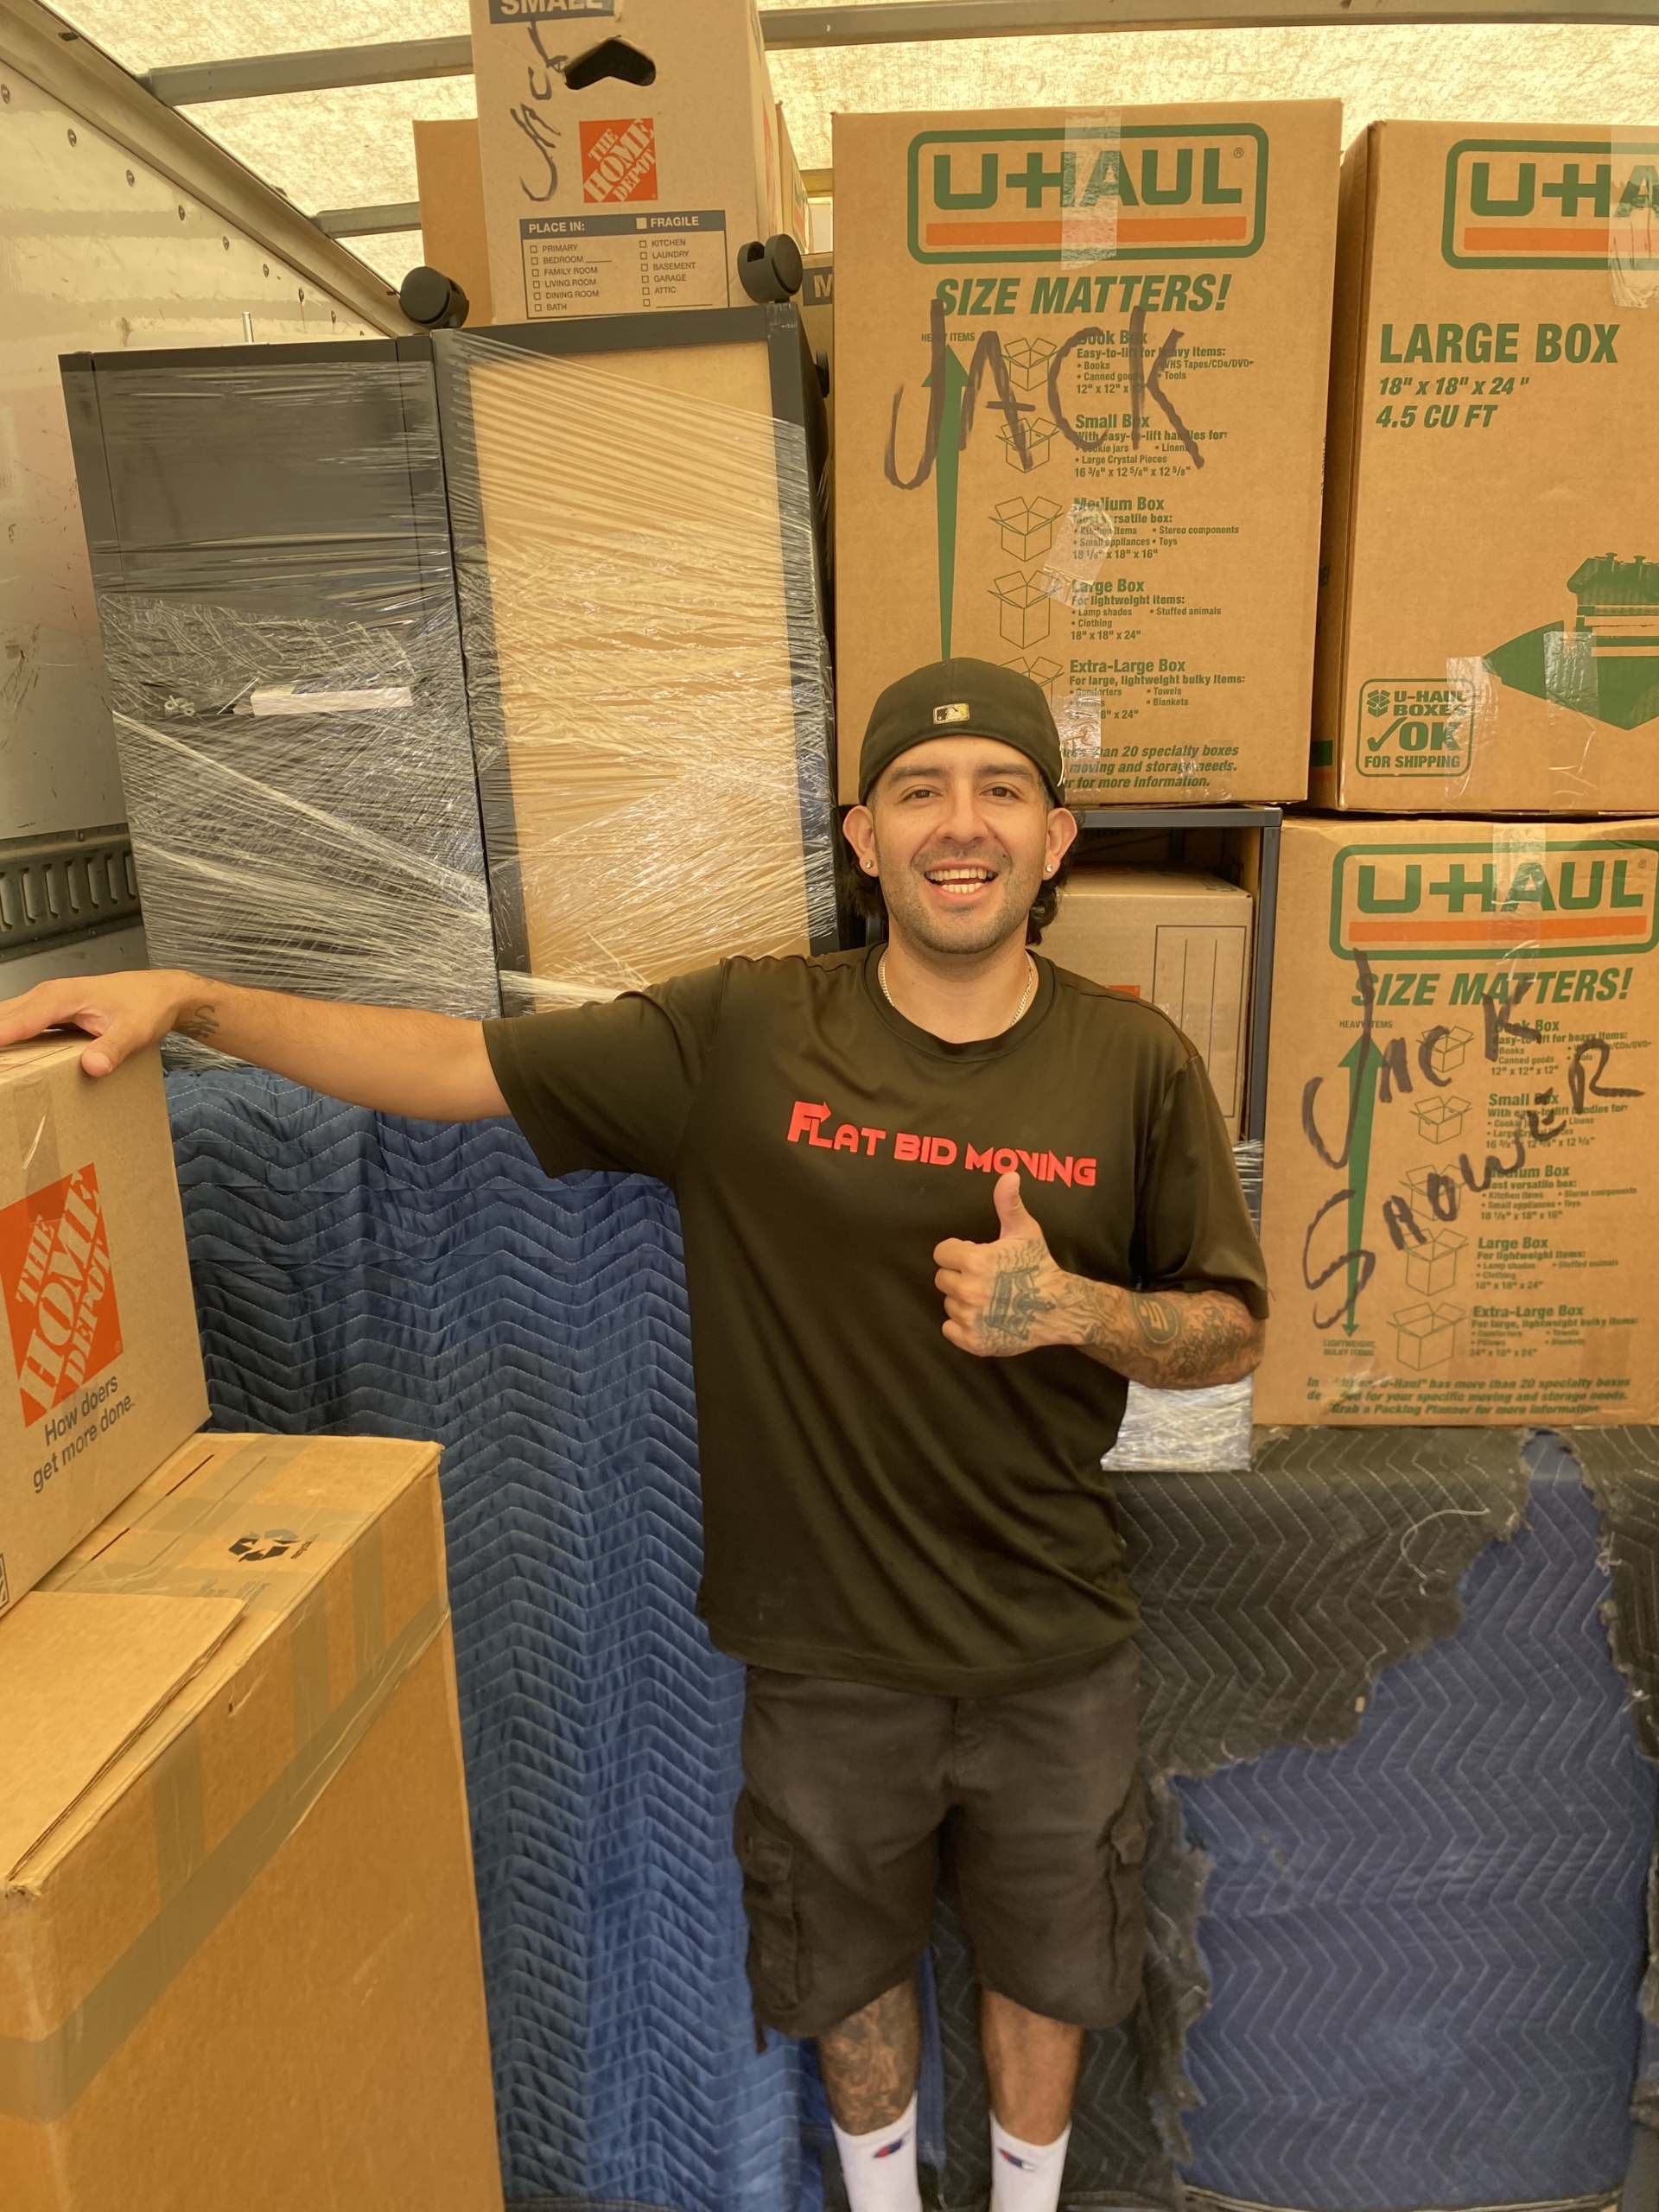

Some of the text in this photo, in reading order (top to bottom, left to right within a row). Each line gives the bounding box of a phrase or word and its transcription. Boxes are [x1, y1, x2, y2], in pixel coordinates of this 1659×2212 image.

[588, 129, 618, 162] THE
[583, 118, 654, 203] HOME
[613, 149, 656, 202] DEPOT
[933, 148, 1242, 210] U-HAUL
[529, 222, 585, 233] PLACE IN:
[651, 217, 699, 227] FRAGILE
[936, 274, 1232, 316] SIZE MATTERS!
[950, 333, 975, 341] ITEMS
[1380, 323, 1620, 364] LARGE BOX
[1077, 384, 1092, 393] 12"
[1105, 384, 1120, 393] 12"
[1380, 378, 1413, 395] 18"
[1415, 381, 1430, 395] x
[1436, 378, 1468, 395] 18"
[1471, 381, 1485, 395] x
[884, 298, 1205, 490] JACK
[1076, 414, 1116, 429] Small
[1376, 404, 1498, 428] 4.5 CU FT
[1113, 444, 1128, 454] jars
[1083, 456, 1106, 465] Large
[1108, 455, 1137, 464] Crystal
[1116, 467, 1127, 476] 12
[1137, 497, 1164, 510] Box
[1151, 513, 1173, 523] box:
[1188, 525, 1239, 535] components
[1160, 537, 1178, 546] Toys
[1115, 550, 1131, 558] 18"
[1142, 549, 1158, 558] 16"
[1117, 578, 1144, 592] Box
[1091, 594, 1150, 607] lightweight
[1078, 607, 1132, 618] Lamp shades
[1157, 607, 1186, 615] Stuffed
[1078, 619, 1112, 628] Clothing
[1071, 631, 1086, 639] 18"
[1097, 630, 1114, 639] 18"
[1124, 630, 1141, 639] 24"
[1070, 658, 1185, 675] Extra-Large Box
[1070, 676, 1086, 685] For
[1089, 676, 1118, 687] large,
[1122, 675, 1179, 686] lightweight
[1183, 674, 1211, 685] bulky
[1122, 710, 1139, 719] 24"
[1399, 721, 1461, 751] OK
[1122, 746, 1239, 759] 20 specialty boxes
[1070, 761, 1115, 775] moving
[1118, 760, 1142, 772] and
[1365, 755, 1459, 767] FOR SHIPPING
[1077, 776, 1210, 788] for more information.
[1357, 859, 1643, 913] U-HAUL
[1351, 968, 1633, 1006] SIZE MATTERS!
[1535, 1020, 1560, 1032] Box
[1553, 1034, 1565, 1043] for
[1532, 1056, 1554, 1065] goods
[1489, 1094, 1529, 1106] Small
[787, 1101, 1096, 1187] FLAT BID MOVING
[1545, 1165, 1570, 1177] Box
[1478, 1236, 1548, 1250] Large Box
[16, 1214, 54, 1307] THE
[19, 1170, 101, 1410] HOME
[66, 1238, 111, 1387] DEPOT
[1473, 1305, 1584, 1319] Extra-Large Box
[45, 1376, 118, 1446] How doers
[34, 1452, 59, 1494] get
[62, 1425, 97, 1465] more
